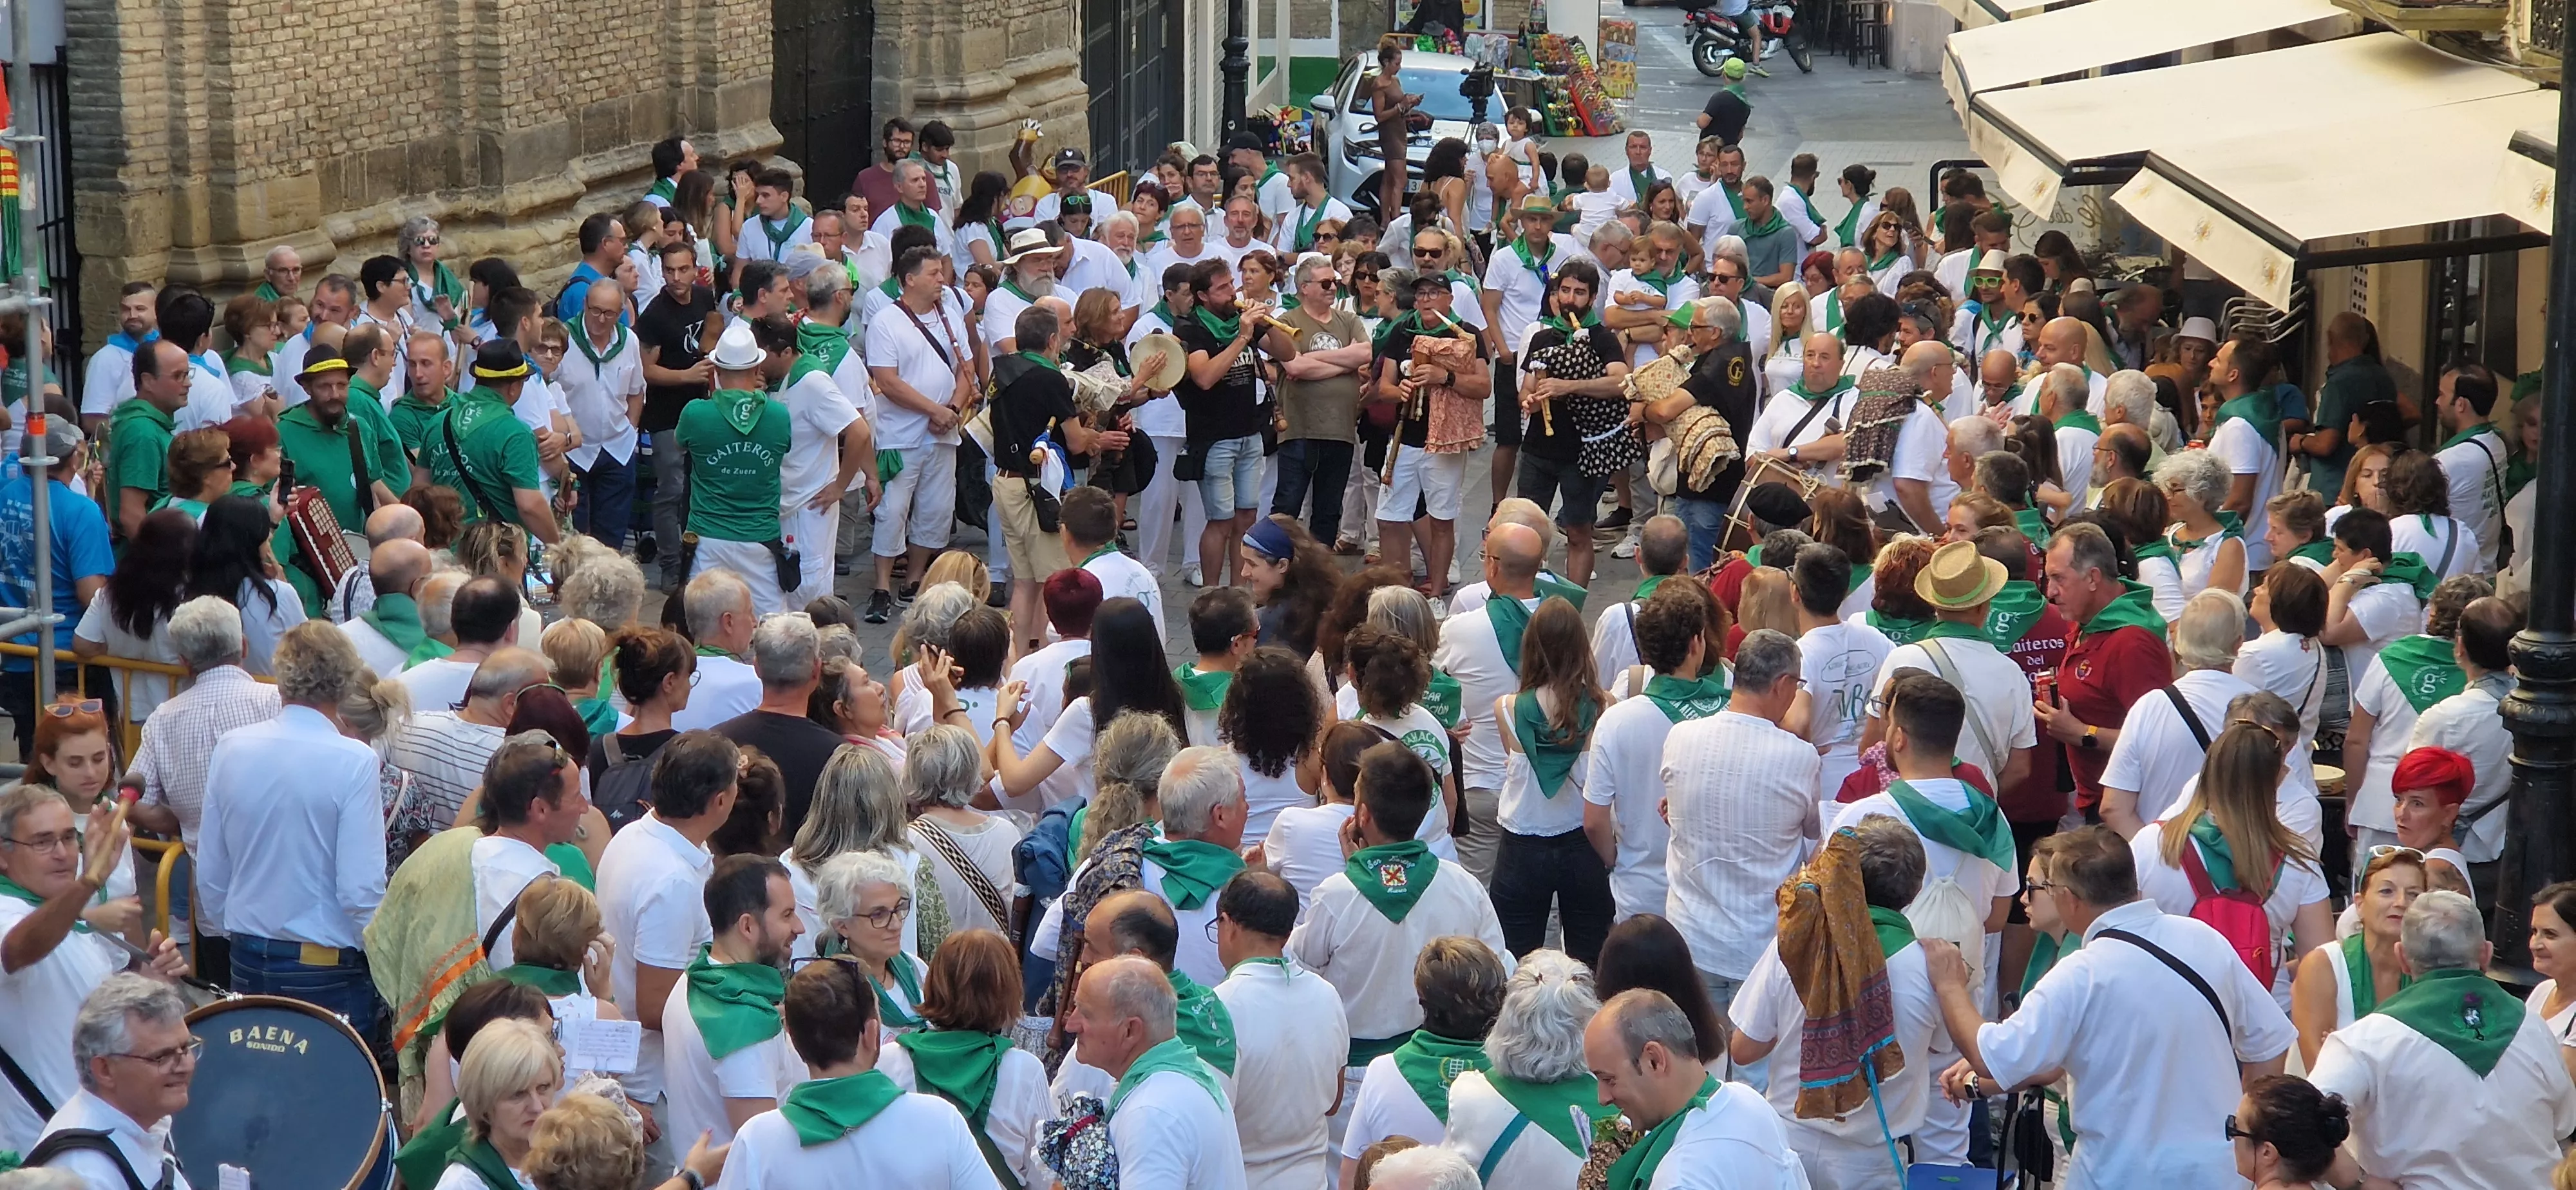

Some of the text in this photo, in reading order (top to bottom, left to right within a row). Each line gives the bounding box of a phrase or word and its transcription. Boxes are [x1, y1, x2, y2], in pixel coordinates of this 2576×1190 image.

[706, 441, 774, 467] GAITEROS
[2003, 638, 2065, 654] aiteros
[2026, 654, 2045, 666] del
[230, 1025, 308, 1055] BAENA
[246, 1041, 285, 1053] SONIDO
